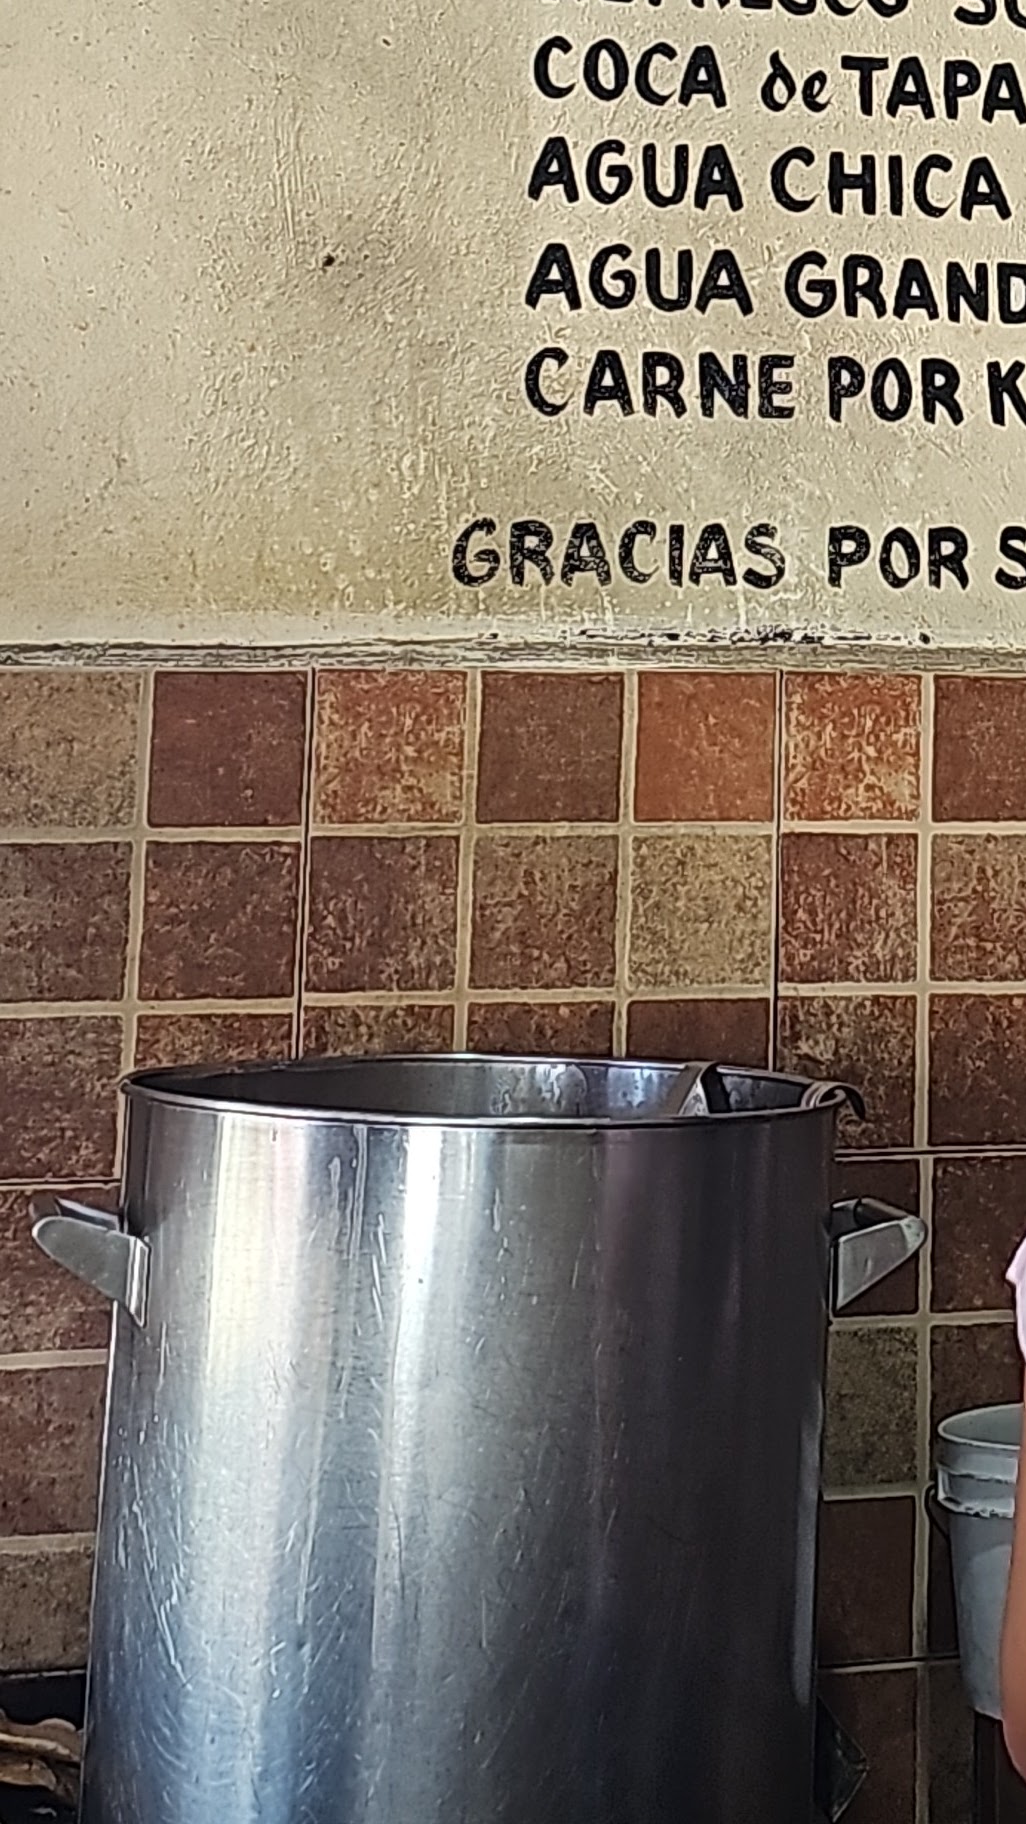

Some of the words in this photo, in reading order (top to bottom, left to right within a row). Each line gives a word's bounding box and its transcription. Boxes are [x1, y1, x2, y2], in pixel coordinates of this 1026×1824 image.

[532, 34, 728, 110] COCA
[759, 49, 831, 114] de
[527, 135, 745, 213] AGUA
[769, 145, 1013, 222] CHICA
[524, 242, 755, 318] AGUA
[523, 346, 796, 420] CARNE
[826, 354, 965, 427] POR
[450, 516, 786, 591] GRACIAS
[826, 524, 970, 591] POR
